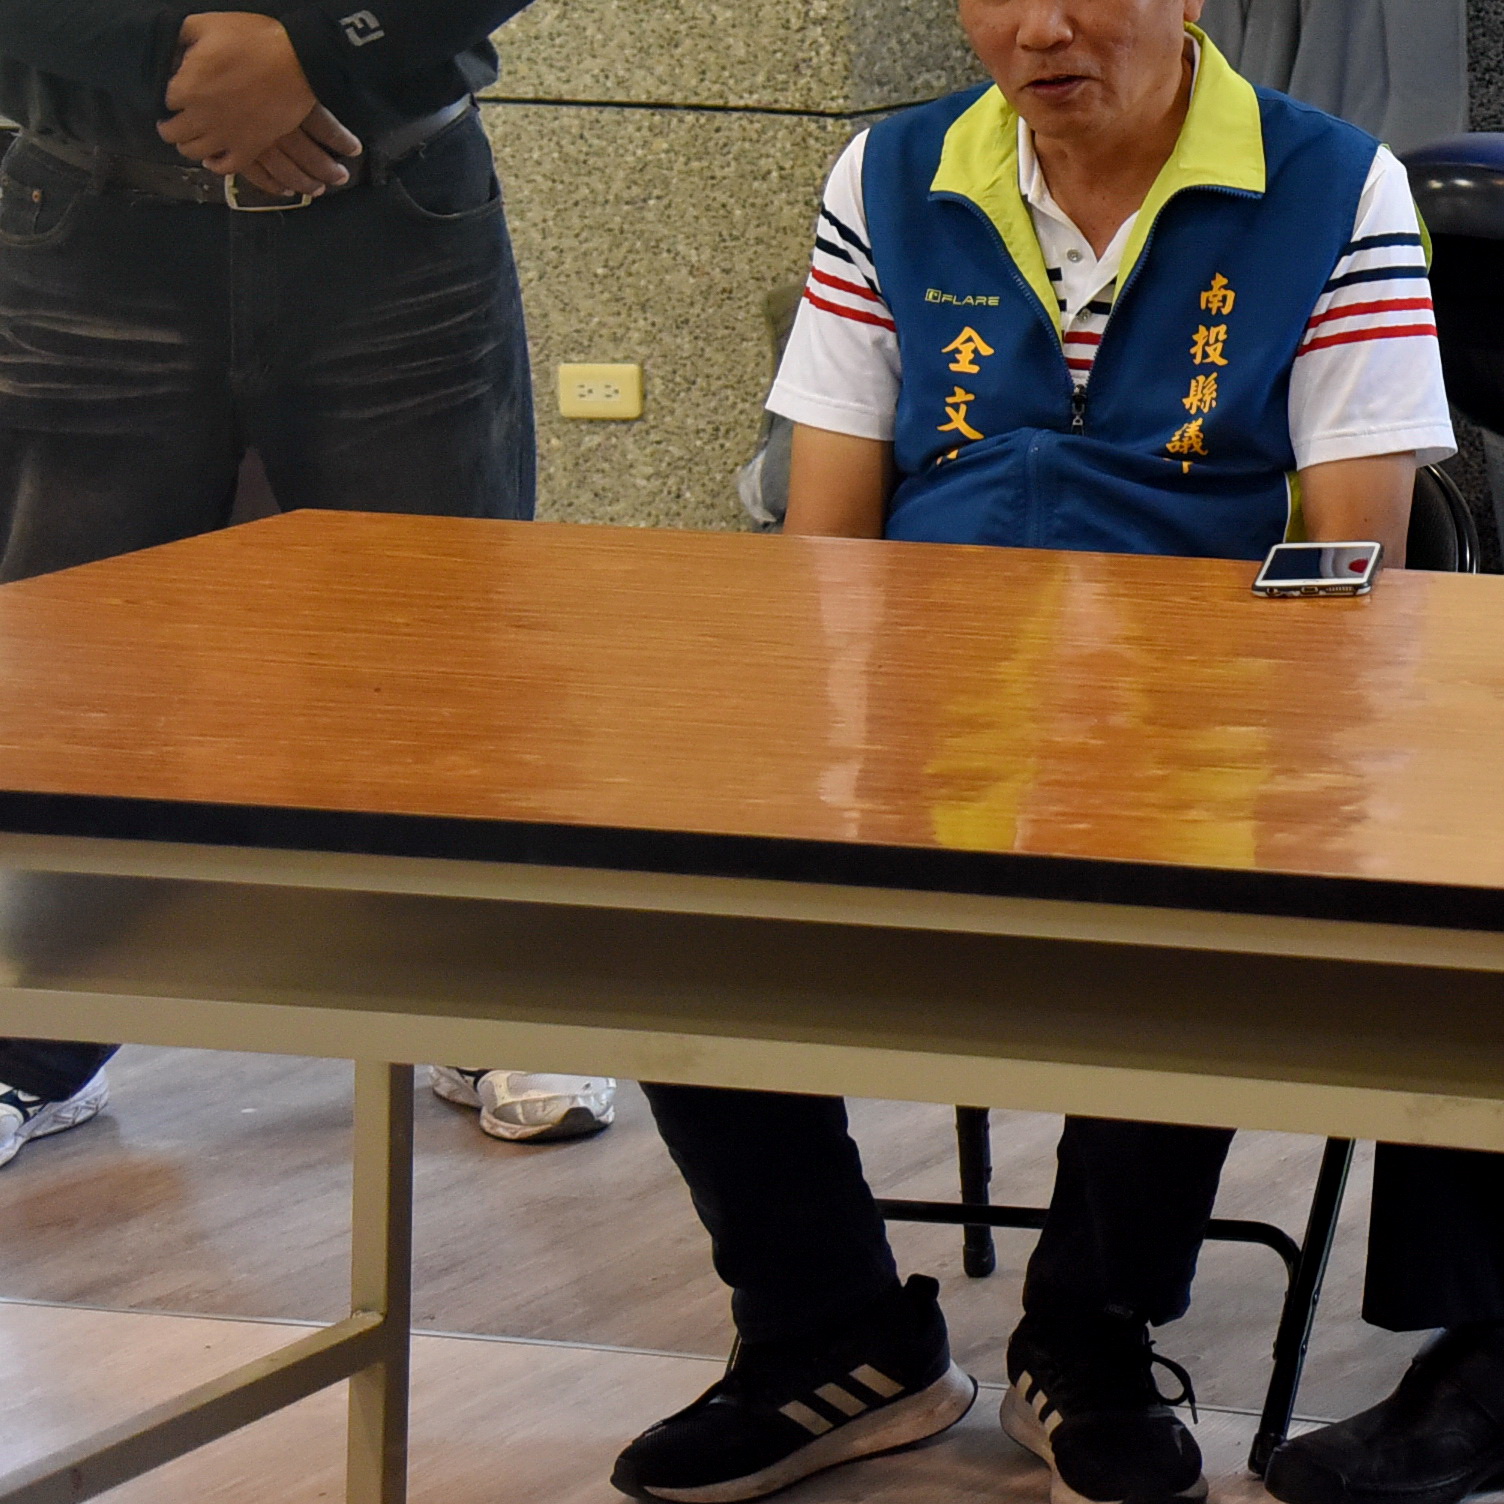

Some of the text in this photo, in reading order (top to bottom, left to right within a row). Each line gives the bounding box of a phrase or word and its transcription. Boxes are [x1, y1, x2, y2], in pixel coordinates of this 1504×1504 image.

[942, 293, 1000, 306] FLARE
[936, 325, 995, 466] 全文
[1165, 271, 1235, 475] 南投縣議
